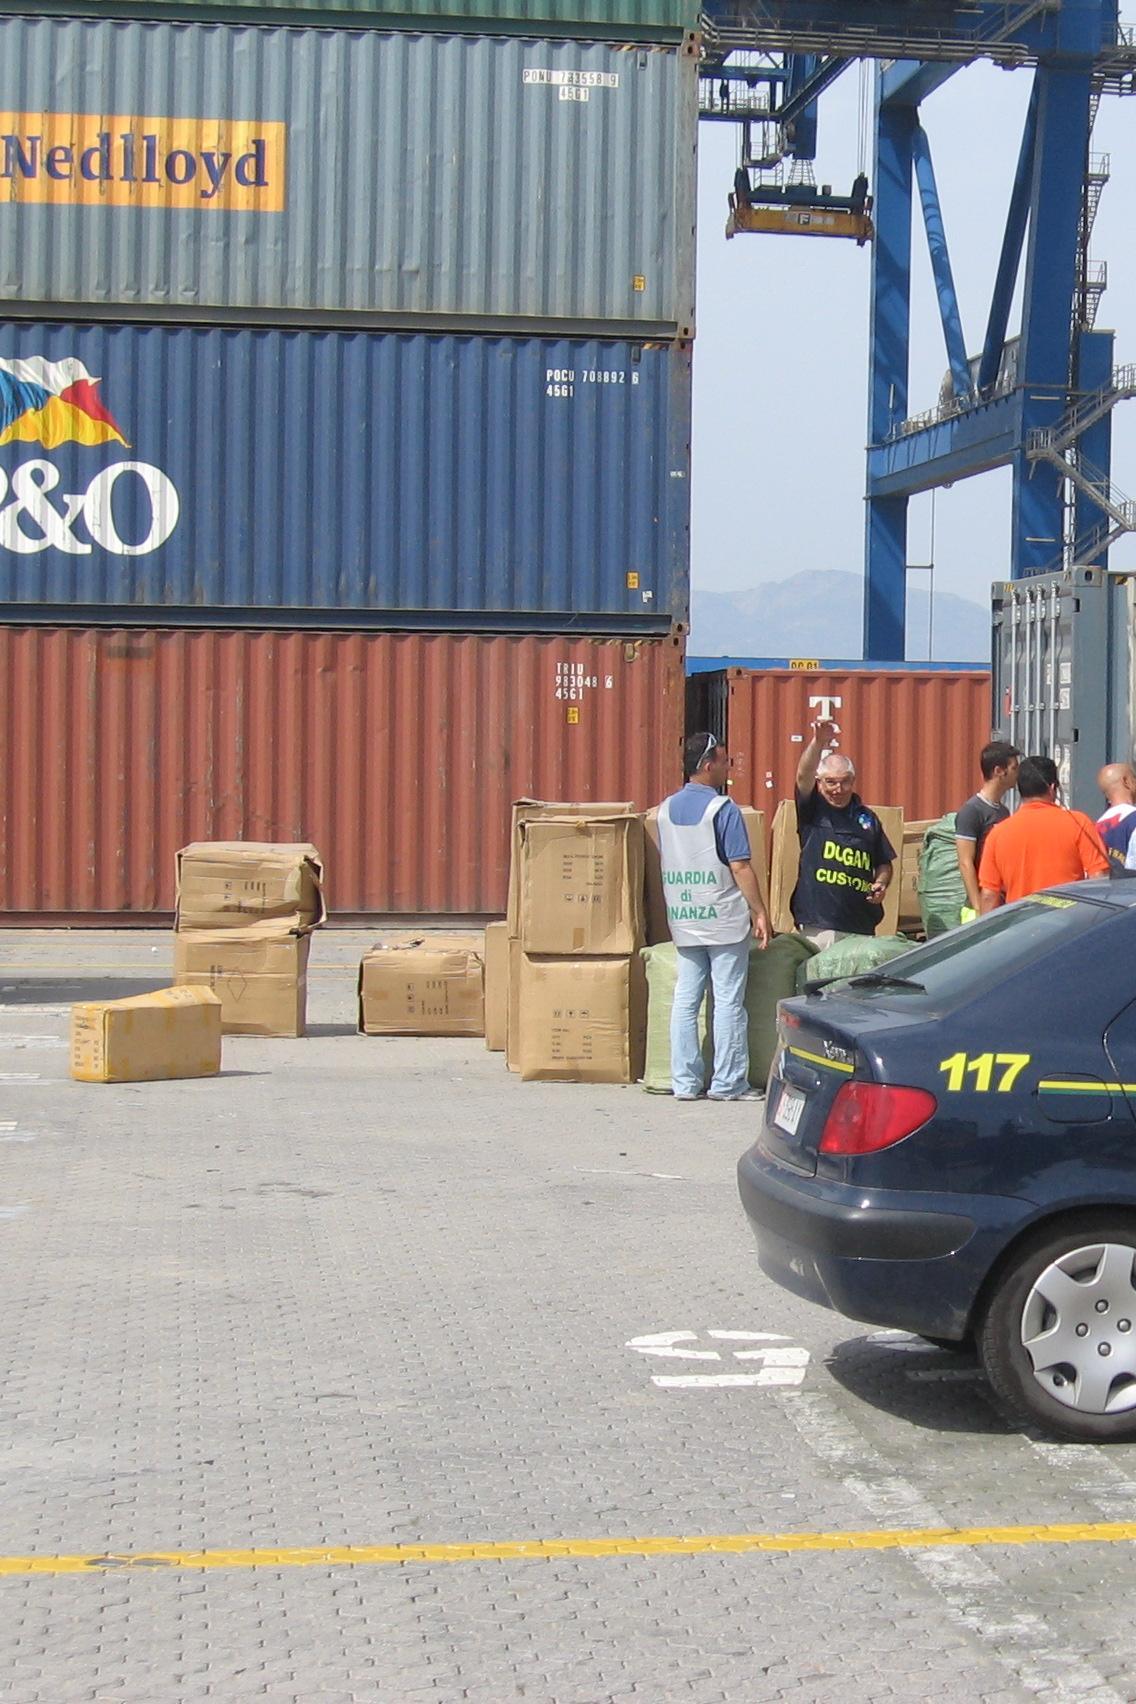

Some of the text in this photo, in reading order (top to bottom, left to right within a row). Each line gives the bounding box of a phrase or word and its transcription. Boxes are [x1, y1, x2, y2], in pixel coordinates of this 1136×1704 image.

[523, 70, 552, 83] PONU
[561, 88, 588, 99] 45G1
[1, 131, 268, 199] Nedlloyd
[546, 369, 574, 382] POCU
[582, 370, 624, 384] 708892
[546, 384, 574, 397] 45G1
[557, 662, 583, 675] TRIU
[555, 675, 613, 688] 983048 6
[555, 687, 583, 700] 45G1
[680, 889, 692, 902] di
[940, 1052, 1030, 1092] 117
